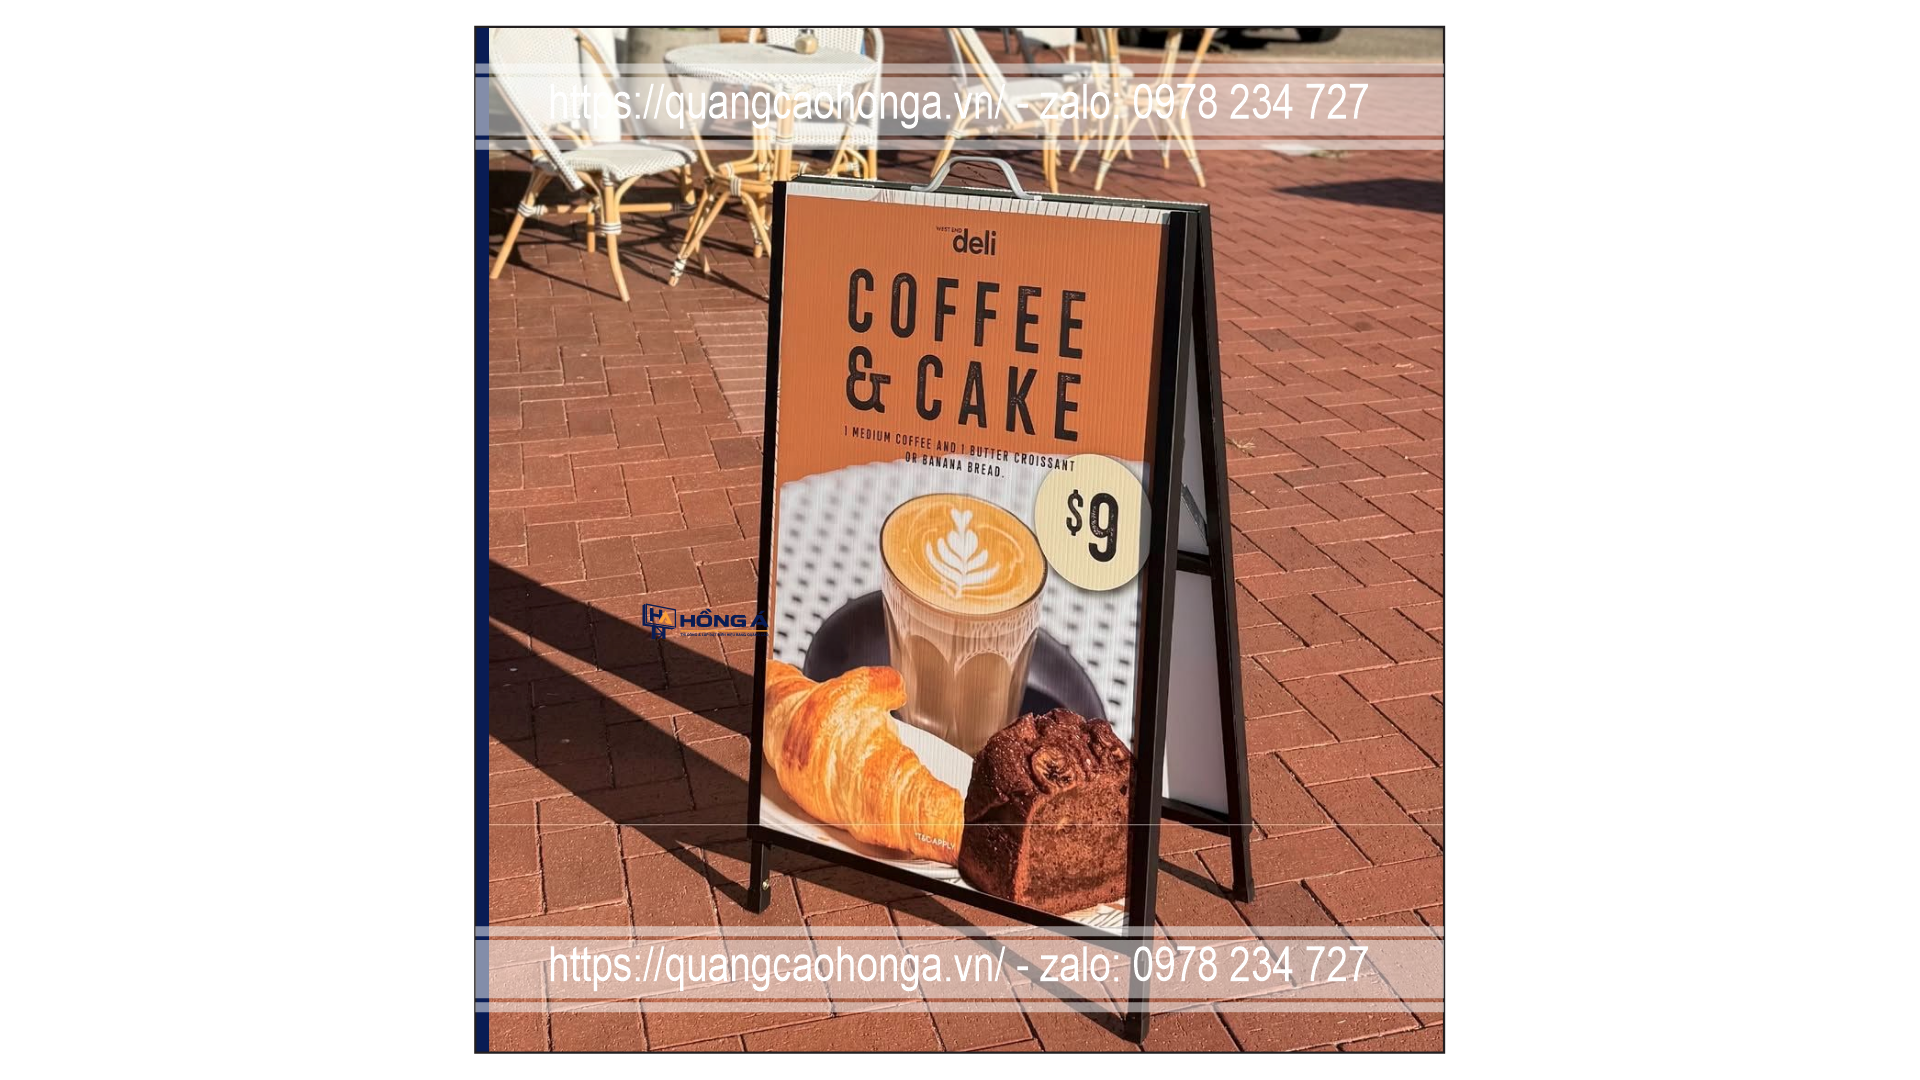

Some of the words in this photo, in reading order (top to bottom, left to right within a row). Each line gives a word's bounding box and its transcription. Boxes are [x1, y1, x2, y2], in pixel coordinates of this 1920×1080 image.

[953, 228, 996, 255] deli
[848, 268, 1086, 359] COFFEE
[846, 346, 891, 413] &
[916, 354, 1081, 442] CAKE
[852, 427, 891, 443] MEDIUM
[896, 433, 931, 450] COFFEE
[936, 440, 956, 453] AND
[970, 445, 1008, 462] BUTTER
[1014, 453, 1075, 472] CROISSANT
[905, 451, 917, 464] OR
[922, 455, 962, 471] BANANA
[967, 462, 1005, 478] BREAD.
[1066, 489, 1118, 562] $9
